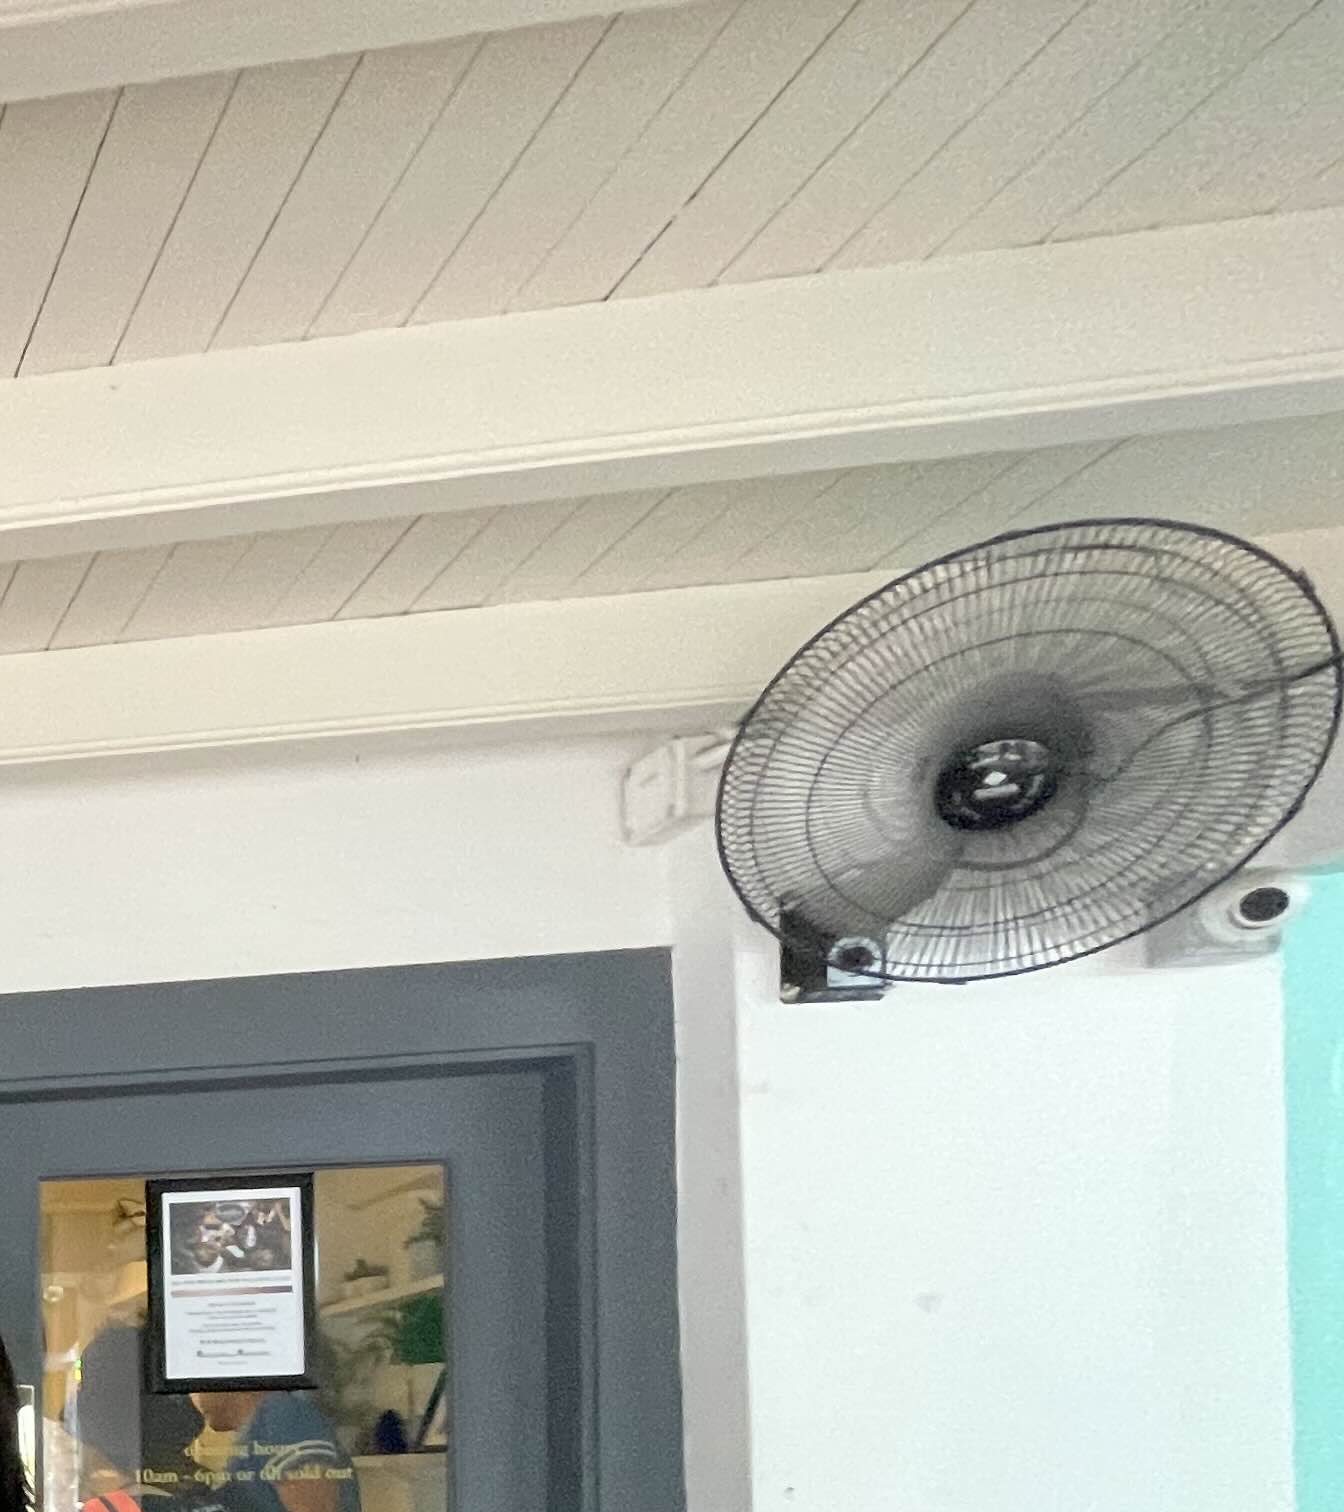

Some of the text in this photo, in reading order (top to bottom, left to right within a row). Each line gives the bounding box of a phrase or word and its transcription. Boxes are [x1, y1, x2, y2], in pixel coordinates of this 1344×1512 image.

[136, 1468, 179, 1483] 10am
[236, 1470, 256, 1482] or
[325, 1467, 354, 1480] out
